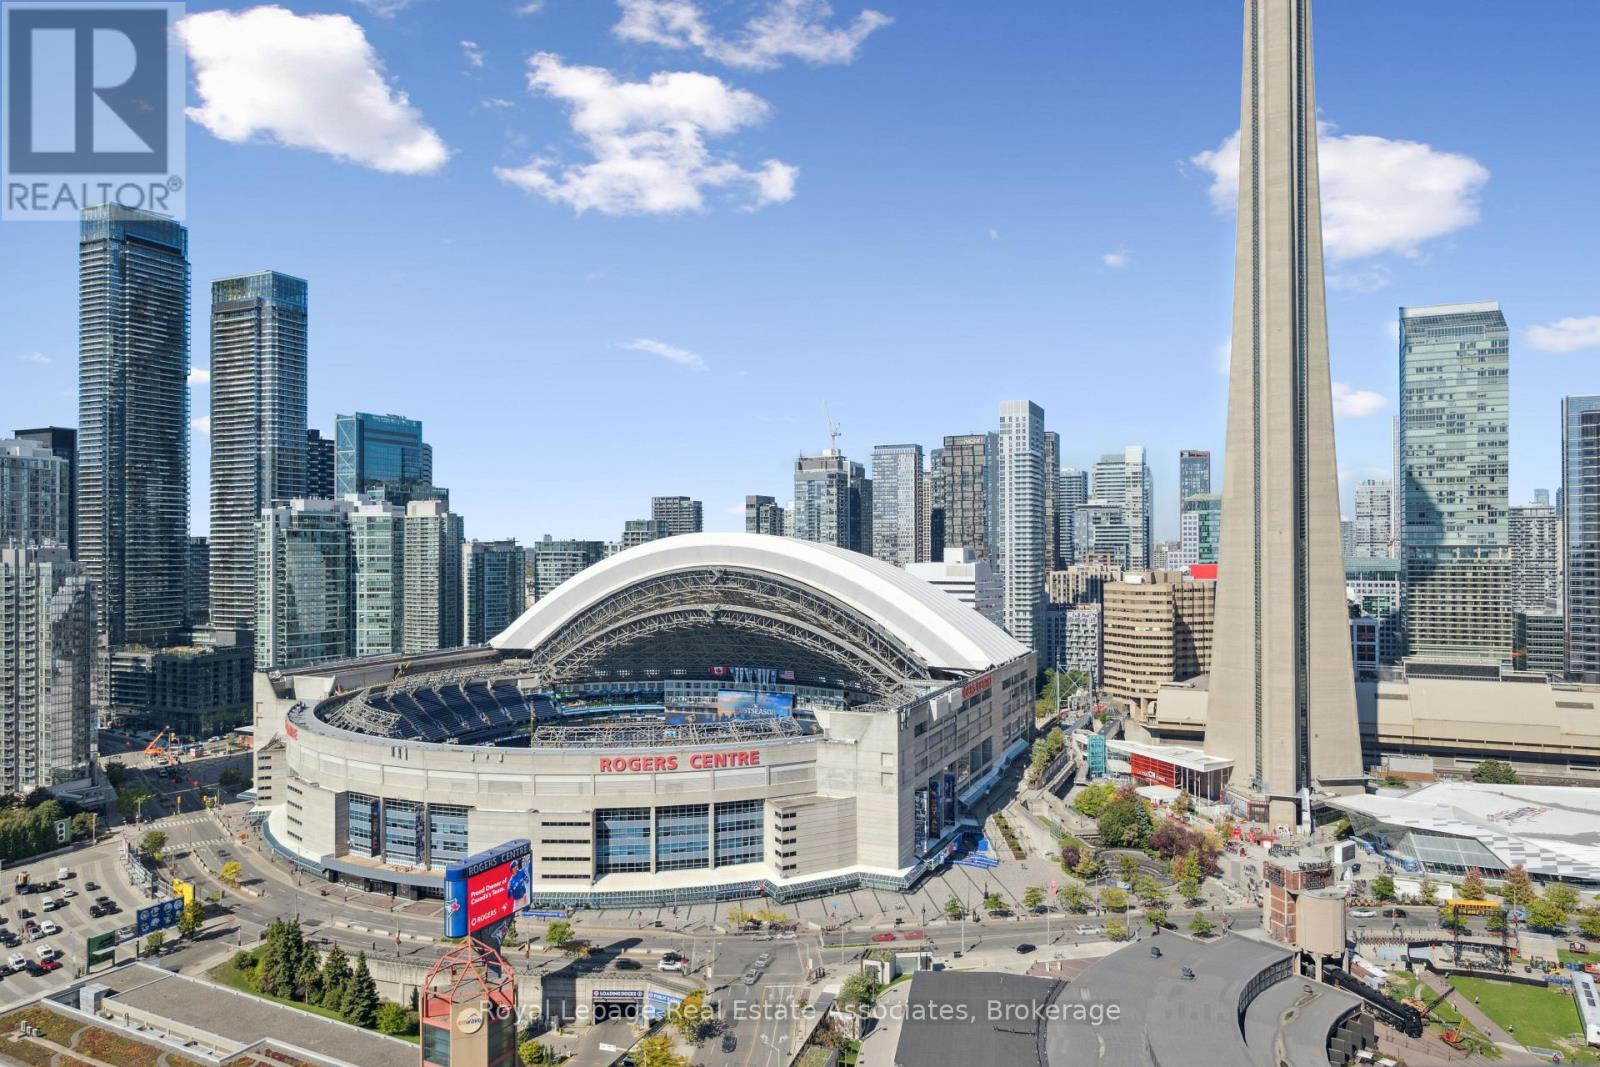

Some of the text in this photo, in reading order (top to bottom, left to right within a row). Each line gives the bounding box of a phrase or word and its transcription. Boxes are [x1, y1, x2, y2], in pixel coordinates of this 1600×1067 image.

[599, 750, 760, 773] ROGERS CENTRE
[468, 845, 528, 876] ROGERS CENTRE
[471, 887, 485, 898] Proud
[485, 881, 501, 891] Owner
[477, 909, 497, 922] ROGERS
